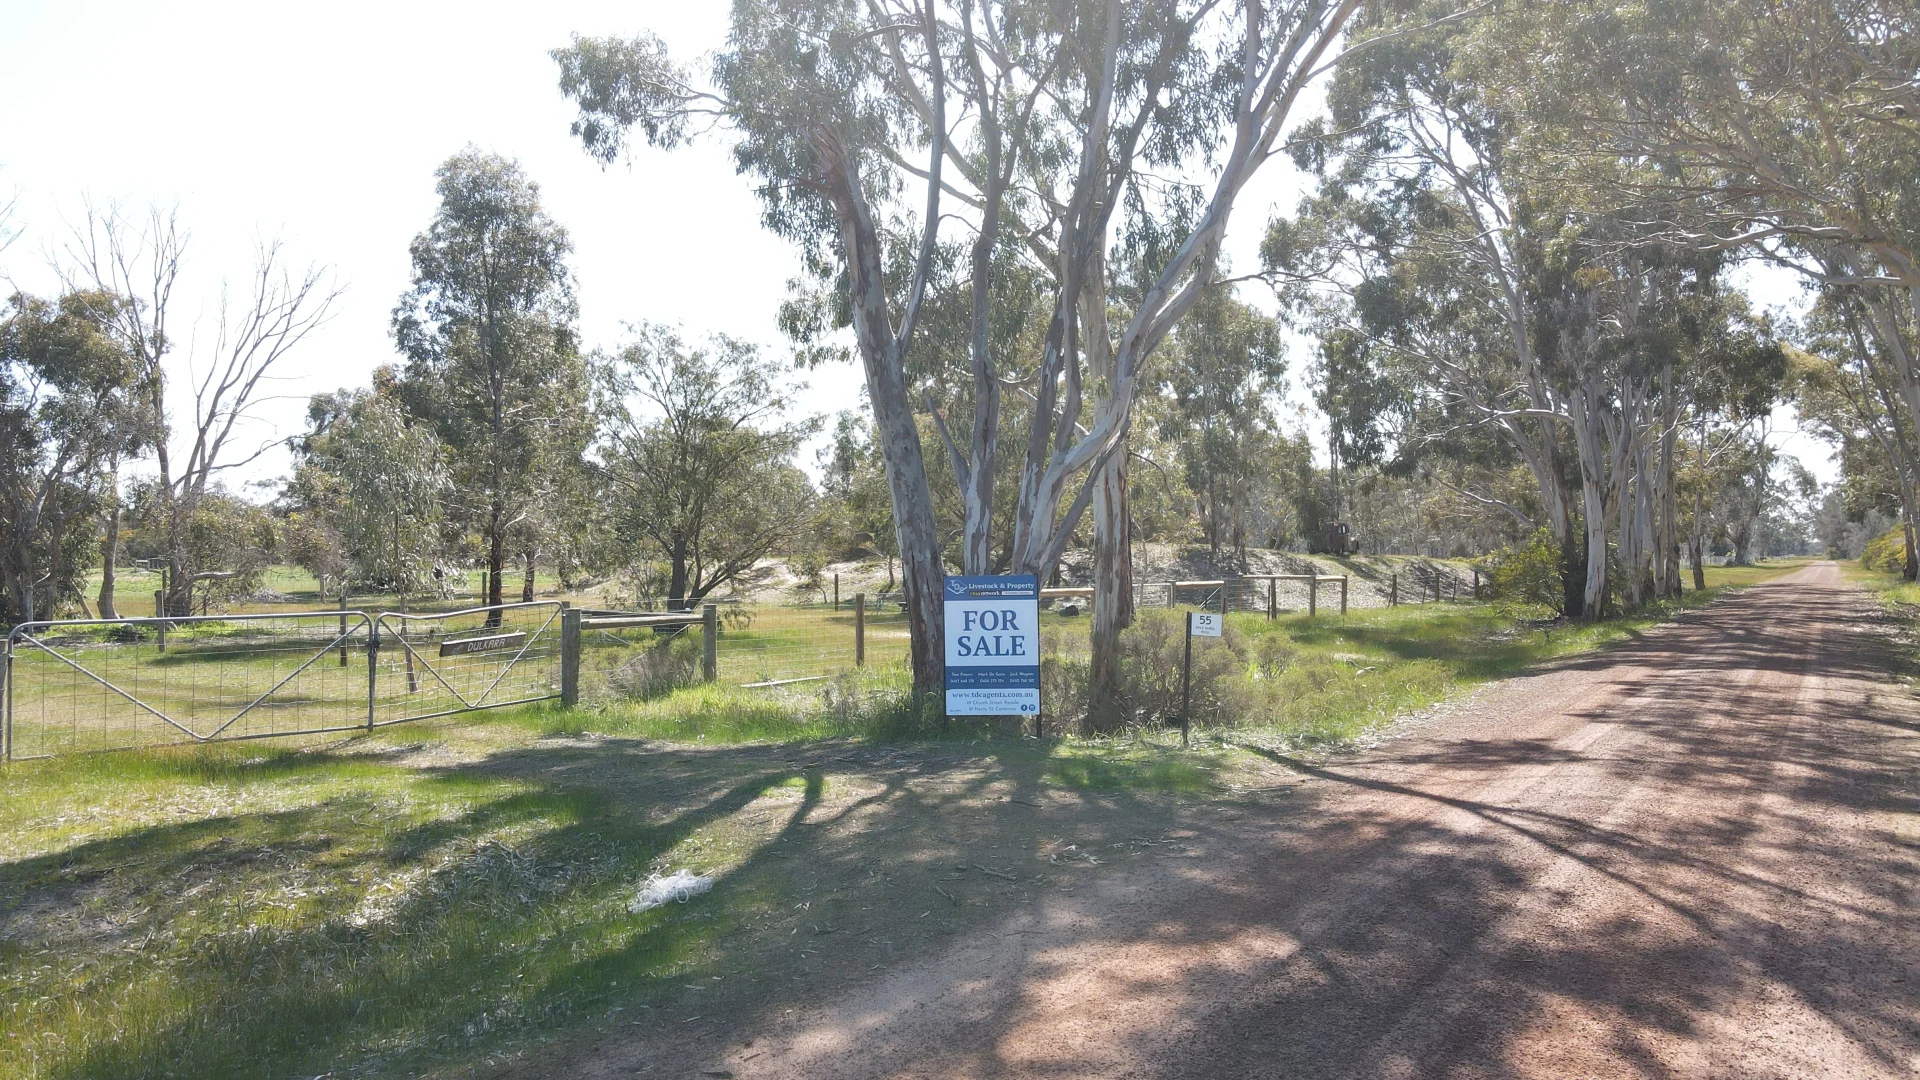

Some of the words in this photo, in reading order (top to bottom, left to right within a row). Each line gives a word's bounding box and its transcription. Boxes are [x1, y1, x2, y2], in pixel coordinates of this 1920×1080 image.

[962, 610, 1020, 632] FOR
[1199, 616, 1212, 625] 55
[467, 638, 506, 652] DULKARA
[958, 635, 1026, 657] SALE
